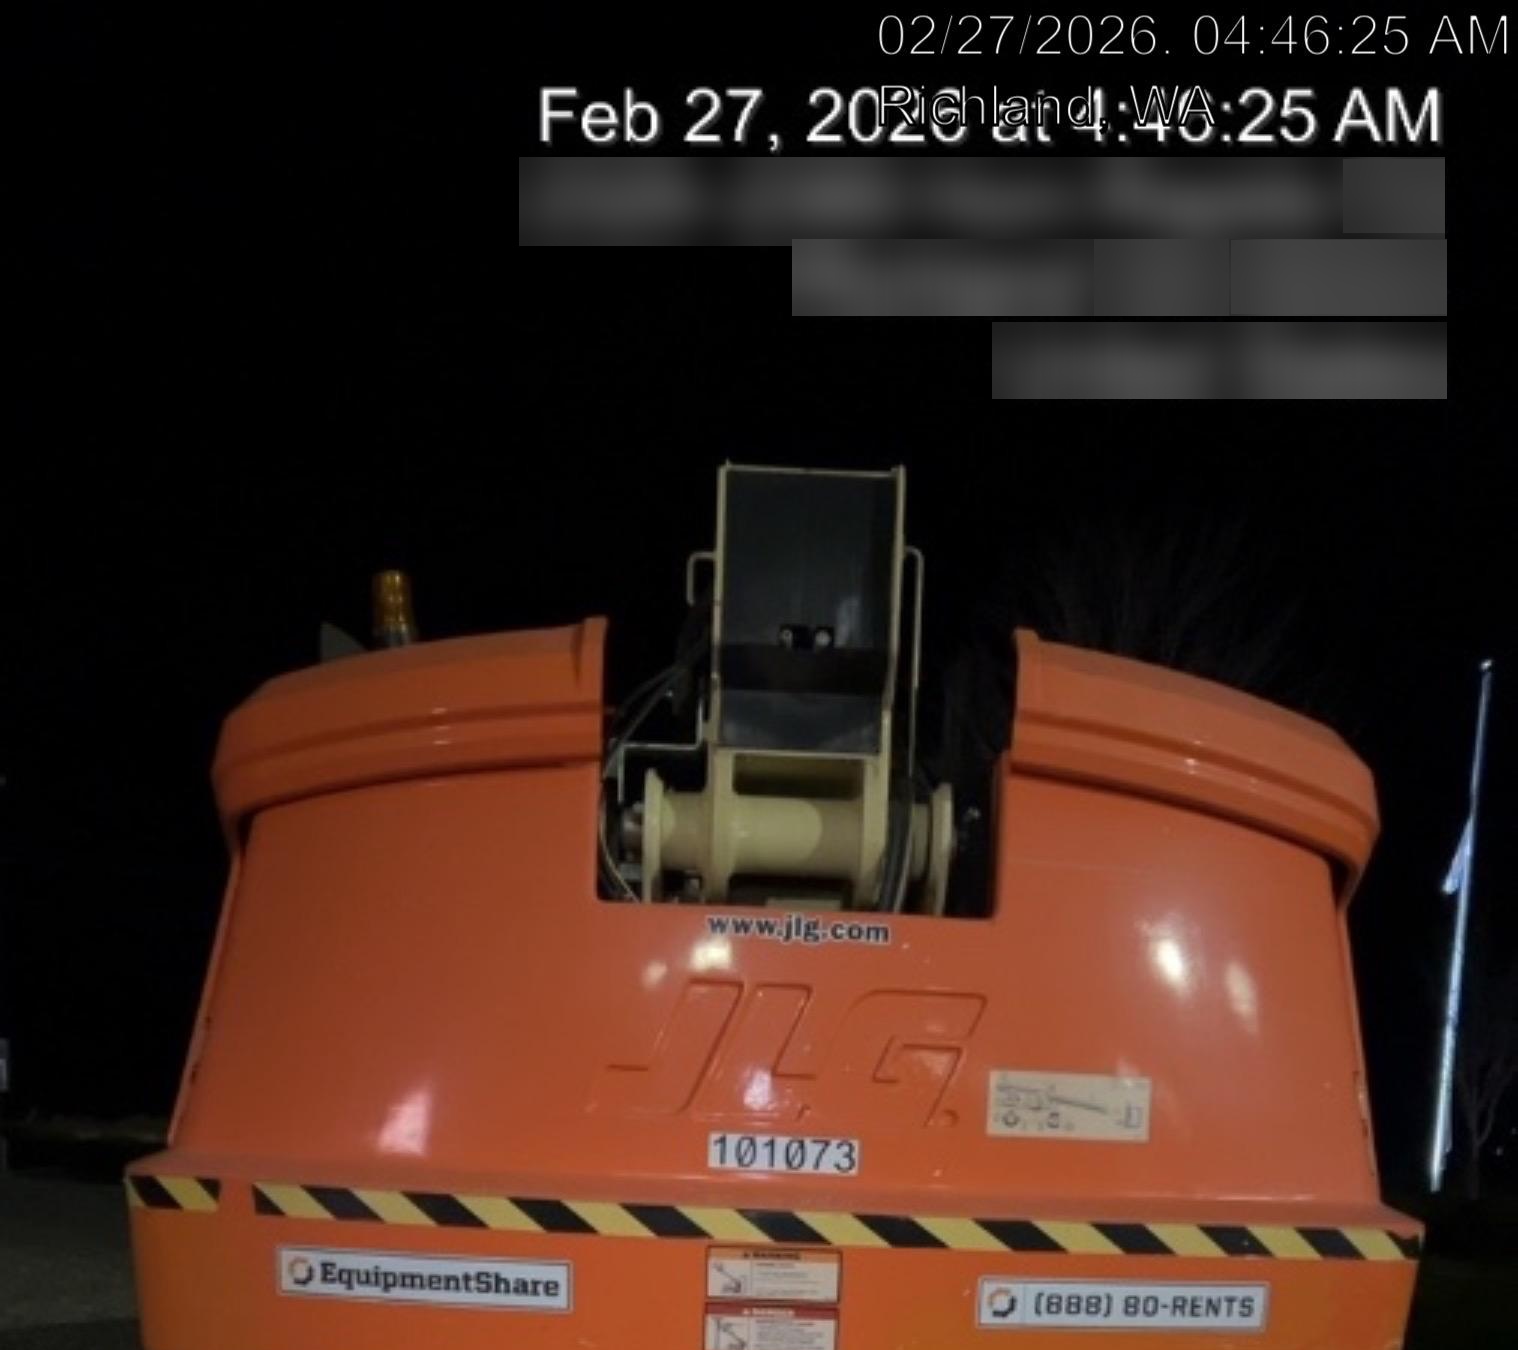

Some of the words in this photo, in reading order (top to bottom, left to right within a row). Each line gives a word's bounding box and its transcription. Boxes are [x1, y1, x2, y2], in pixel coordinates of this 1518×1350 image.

[708, 913, 891, 943] www.jlg.com
[585, 978, 990, 1127] JLG
[712, 1133, 857, 1173] 101073
[319, 1261, 561, 1298] EquipmentShare
[1033, 1292, 1112, 1318] (888)
[1123, 1294, 1256, 1319] 80-RENTS
